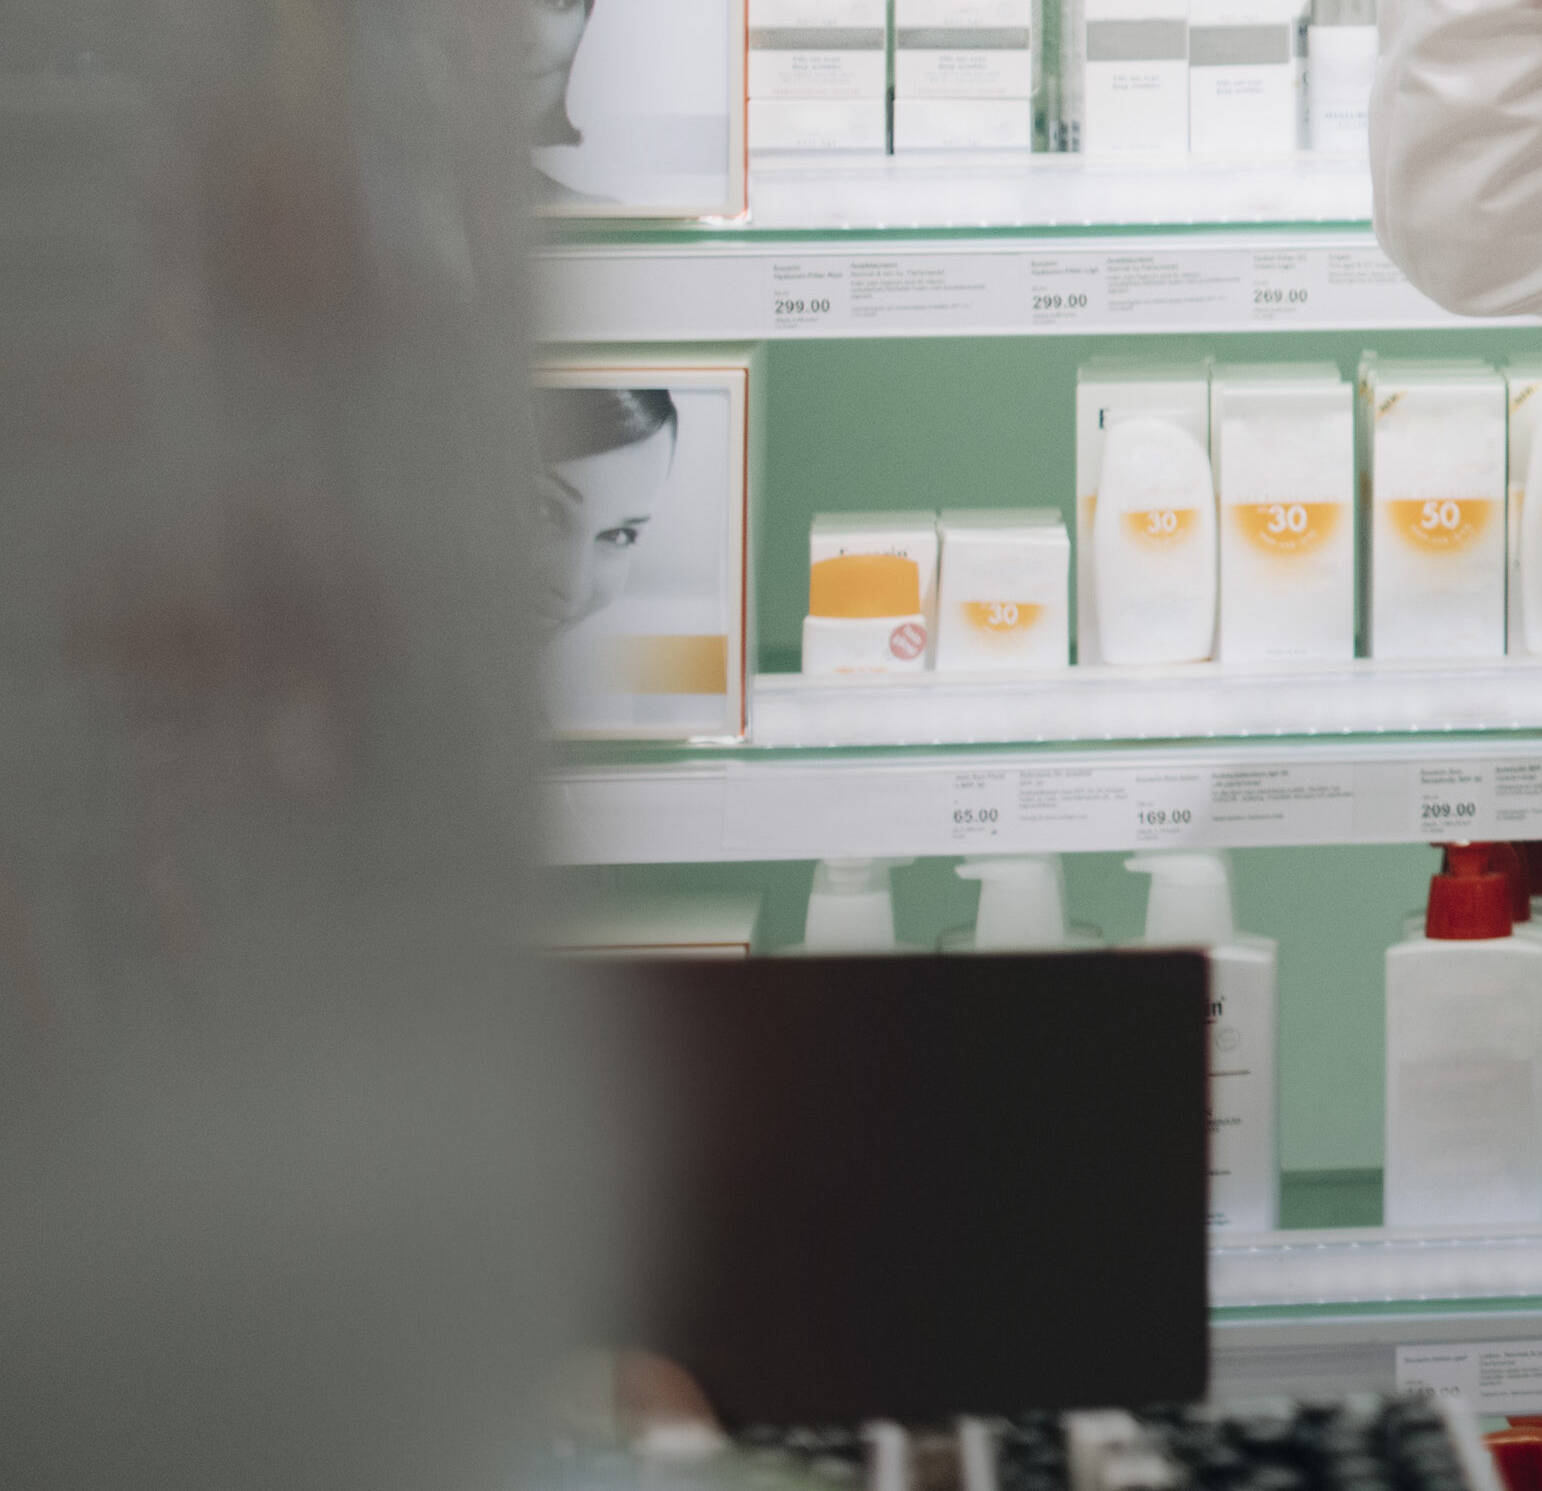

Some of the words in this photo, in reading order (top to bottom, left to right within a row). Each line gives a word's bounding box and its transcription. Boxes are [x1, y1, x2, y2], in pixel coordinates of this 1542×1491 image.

[1033, 293, 1088, 310] 299.00
[1253, 288, 1308, 304] 269.00
[774, 298, 831, 315] 299.00
[1147, 511, 1178, 534] 30
[1267, 505, 1309, 533] 30
[1421, 501, 1461, 530] 50
[988, 604, 1019, 625] 30
[953, 808, 999, 823] 65.00
[1137, 809, 1192, 825] 169.00
[1421, 802, 1476, 819] 209.00
